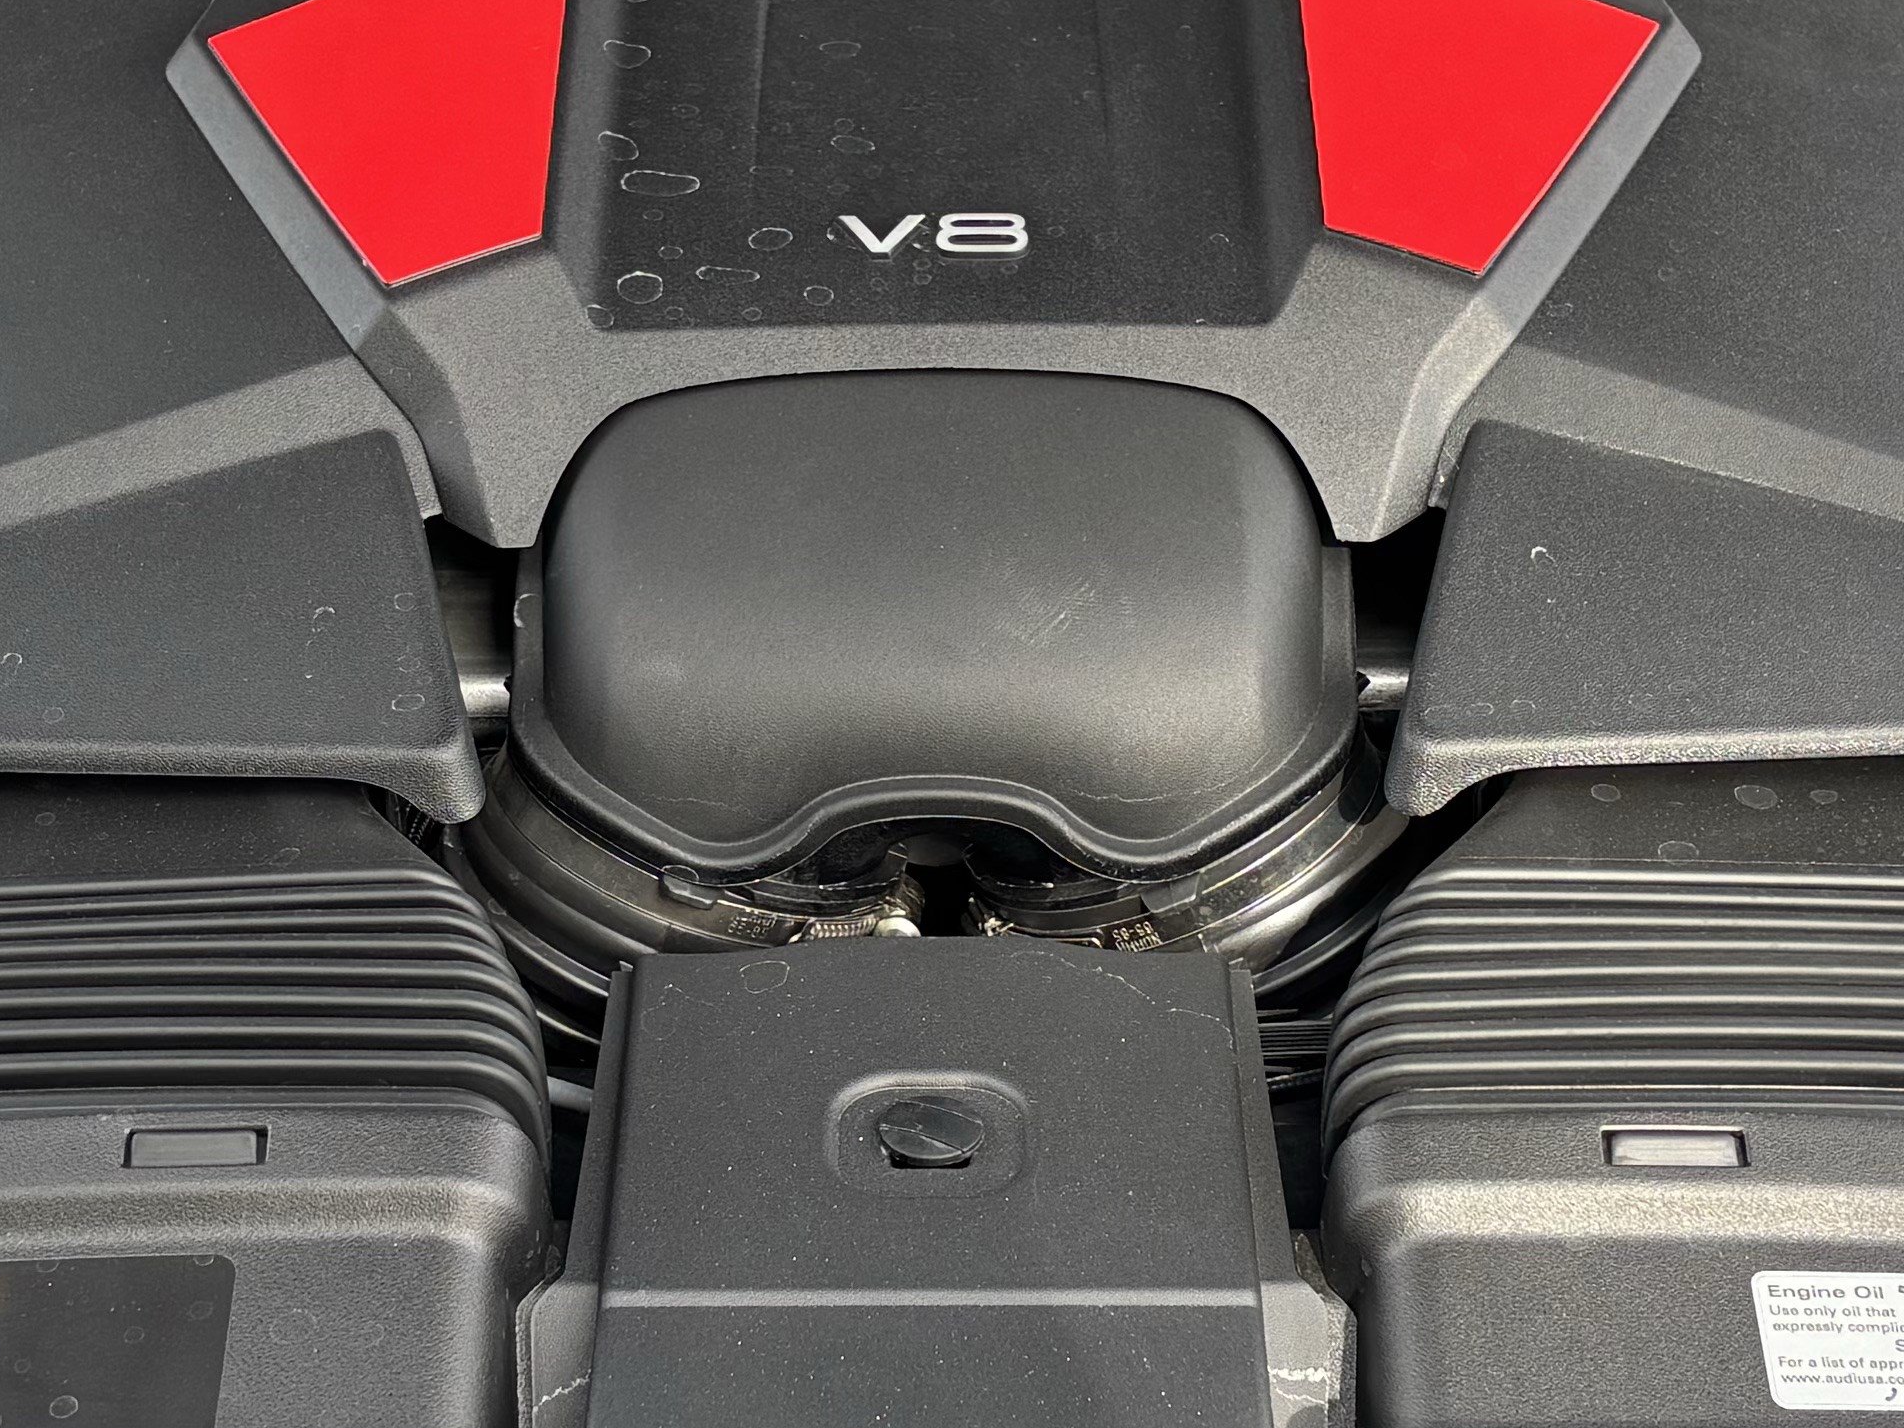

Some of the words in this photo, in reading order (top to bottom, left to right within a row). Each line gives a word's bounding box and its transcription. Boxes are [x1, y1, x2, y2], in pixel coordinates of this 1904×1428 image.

[837, 212, 1030, 260] V8
[1767, 1284, 1846, 1301] Engine
[1854, 1285, 1884, 1300] Oil
[1769, 1304, 1800, 1317] Use
[1803, 1305, 1837, 1319] only
[1842, 1306, 1862, 1317] oil
[1866, 1306, 1897, 1318] that
[1772, 1322, 1844, 1335] expressly
[1778, 1356, 1804, 1368] For
[1808, 1359, 1818, 1368] a
[1821, 1356, 1845, 1368] list
[1849, 1356, 1865, 1368] of
